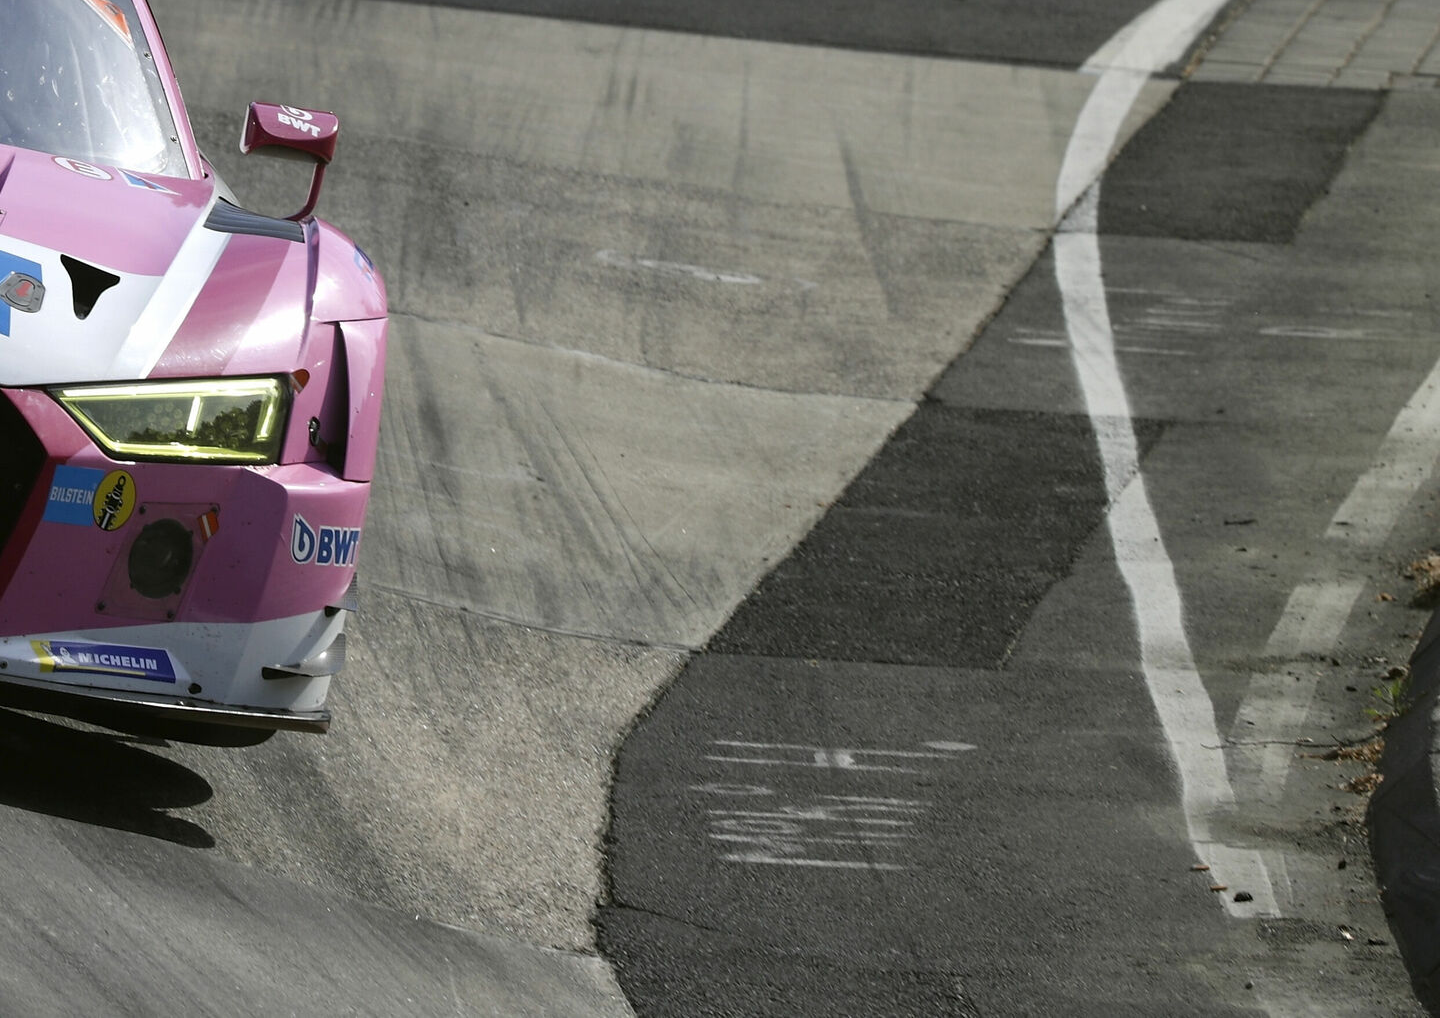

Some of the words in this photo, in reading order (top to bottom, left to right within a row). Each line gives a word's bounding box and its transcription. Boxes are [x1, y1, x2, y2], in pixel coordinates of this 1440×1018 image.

[277, 112, 322, 138] BWT
[49, 486, 95, 505] BILSTEIN
[315, 525, 361, 567] BWT
[78, 651, 158, 671] MICHELIN
